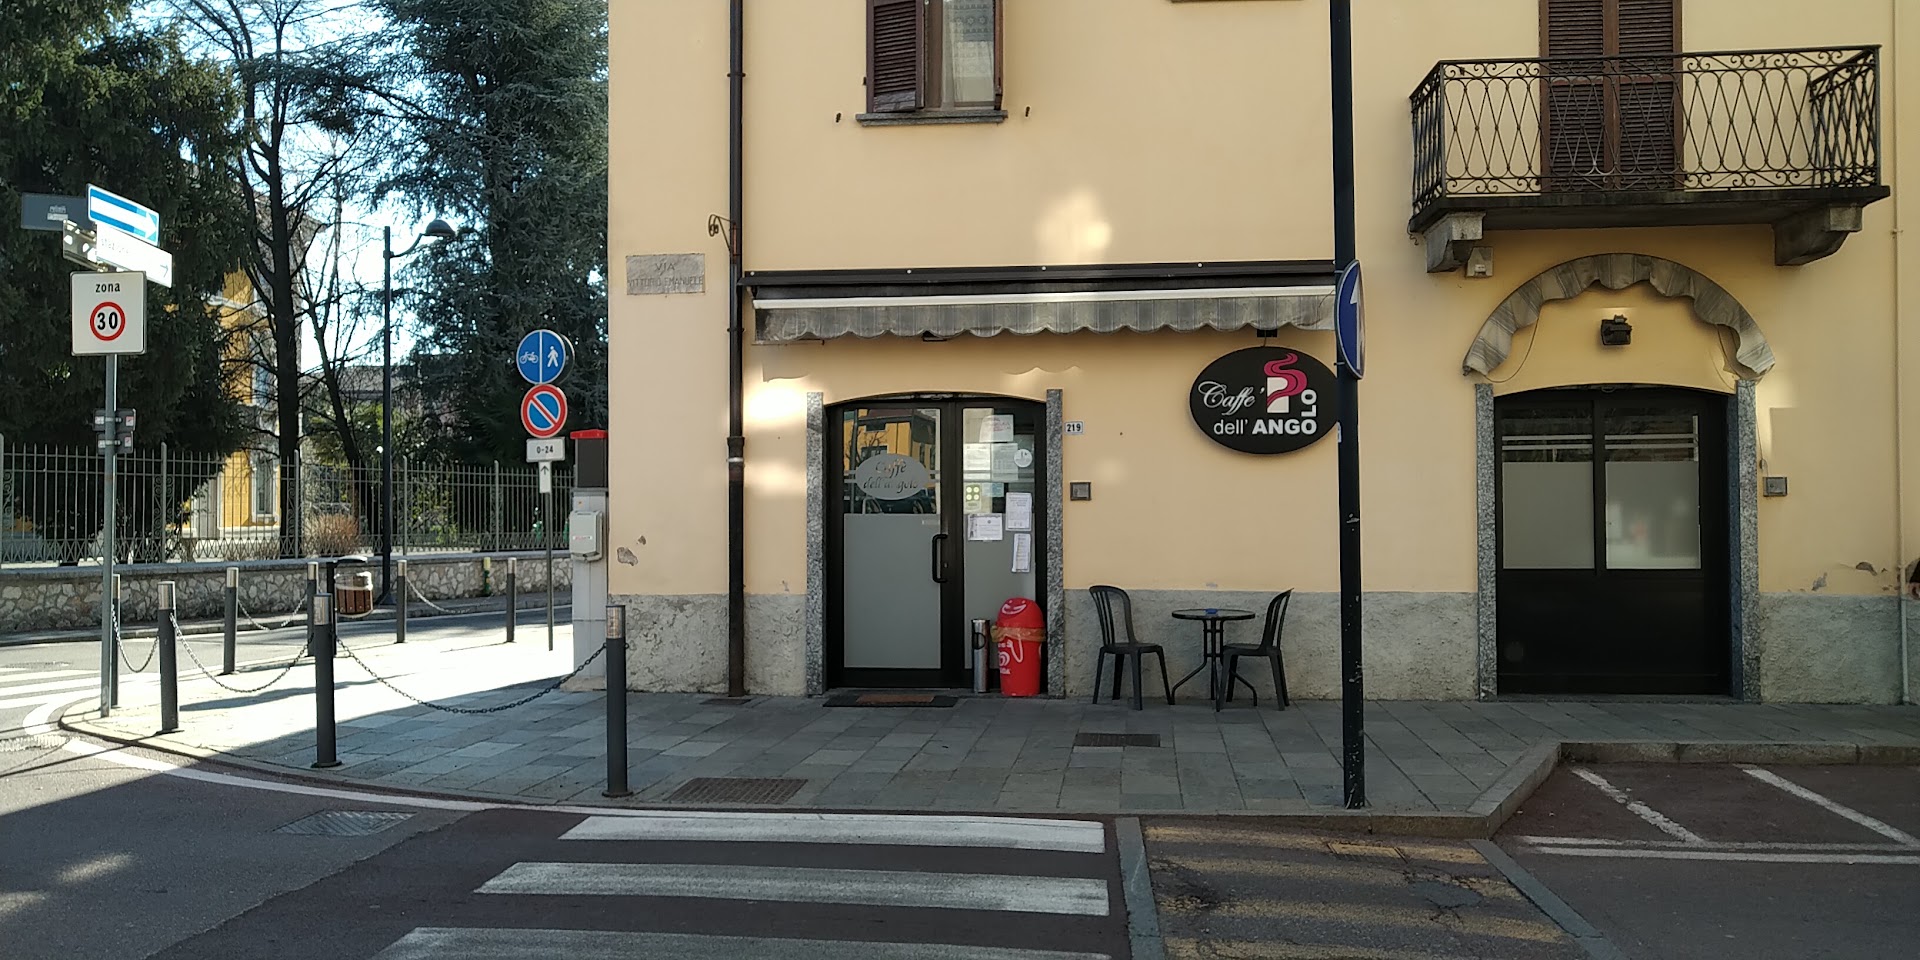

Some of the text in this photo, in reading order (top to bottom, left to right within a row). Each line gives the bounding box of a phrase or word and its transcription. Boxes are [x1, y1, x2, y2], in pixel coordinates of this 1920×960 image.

[654, 262, 675, 272] VIA
[95, 282, 121, 293] zona
[96, 311, 118, 331] 30
[1066, 423, 1081, 432] 219
[1213, 419, 1249, 435] dell'
[536, 445, 554, 454] 0-24
